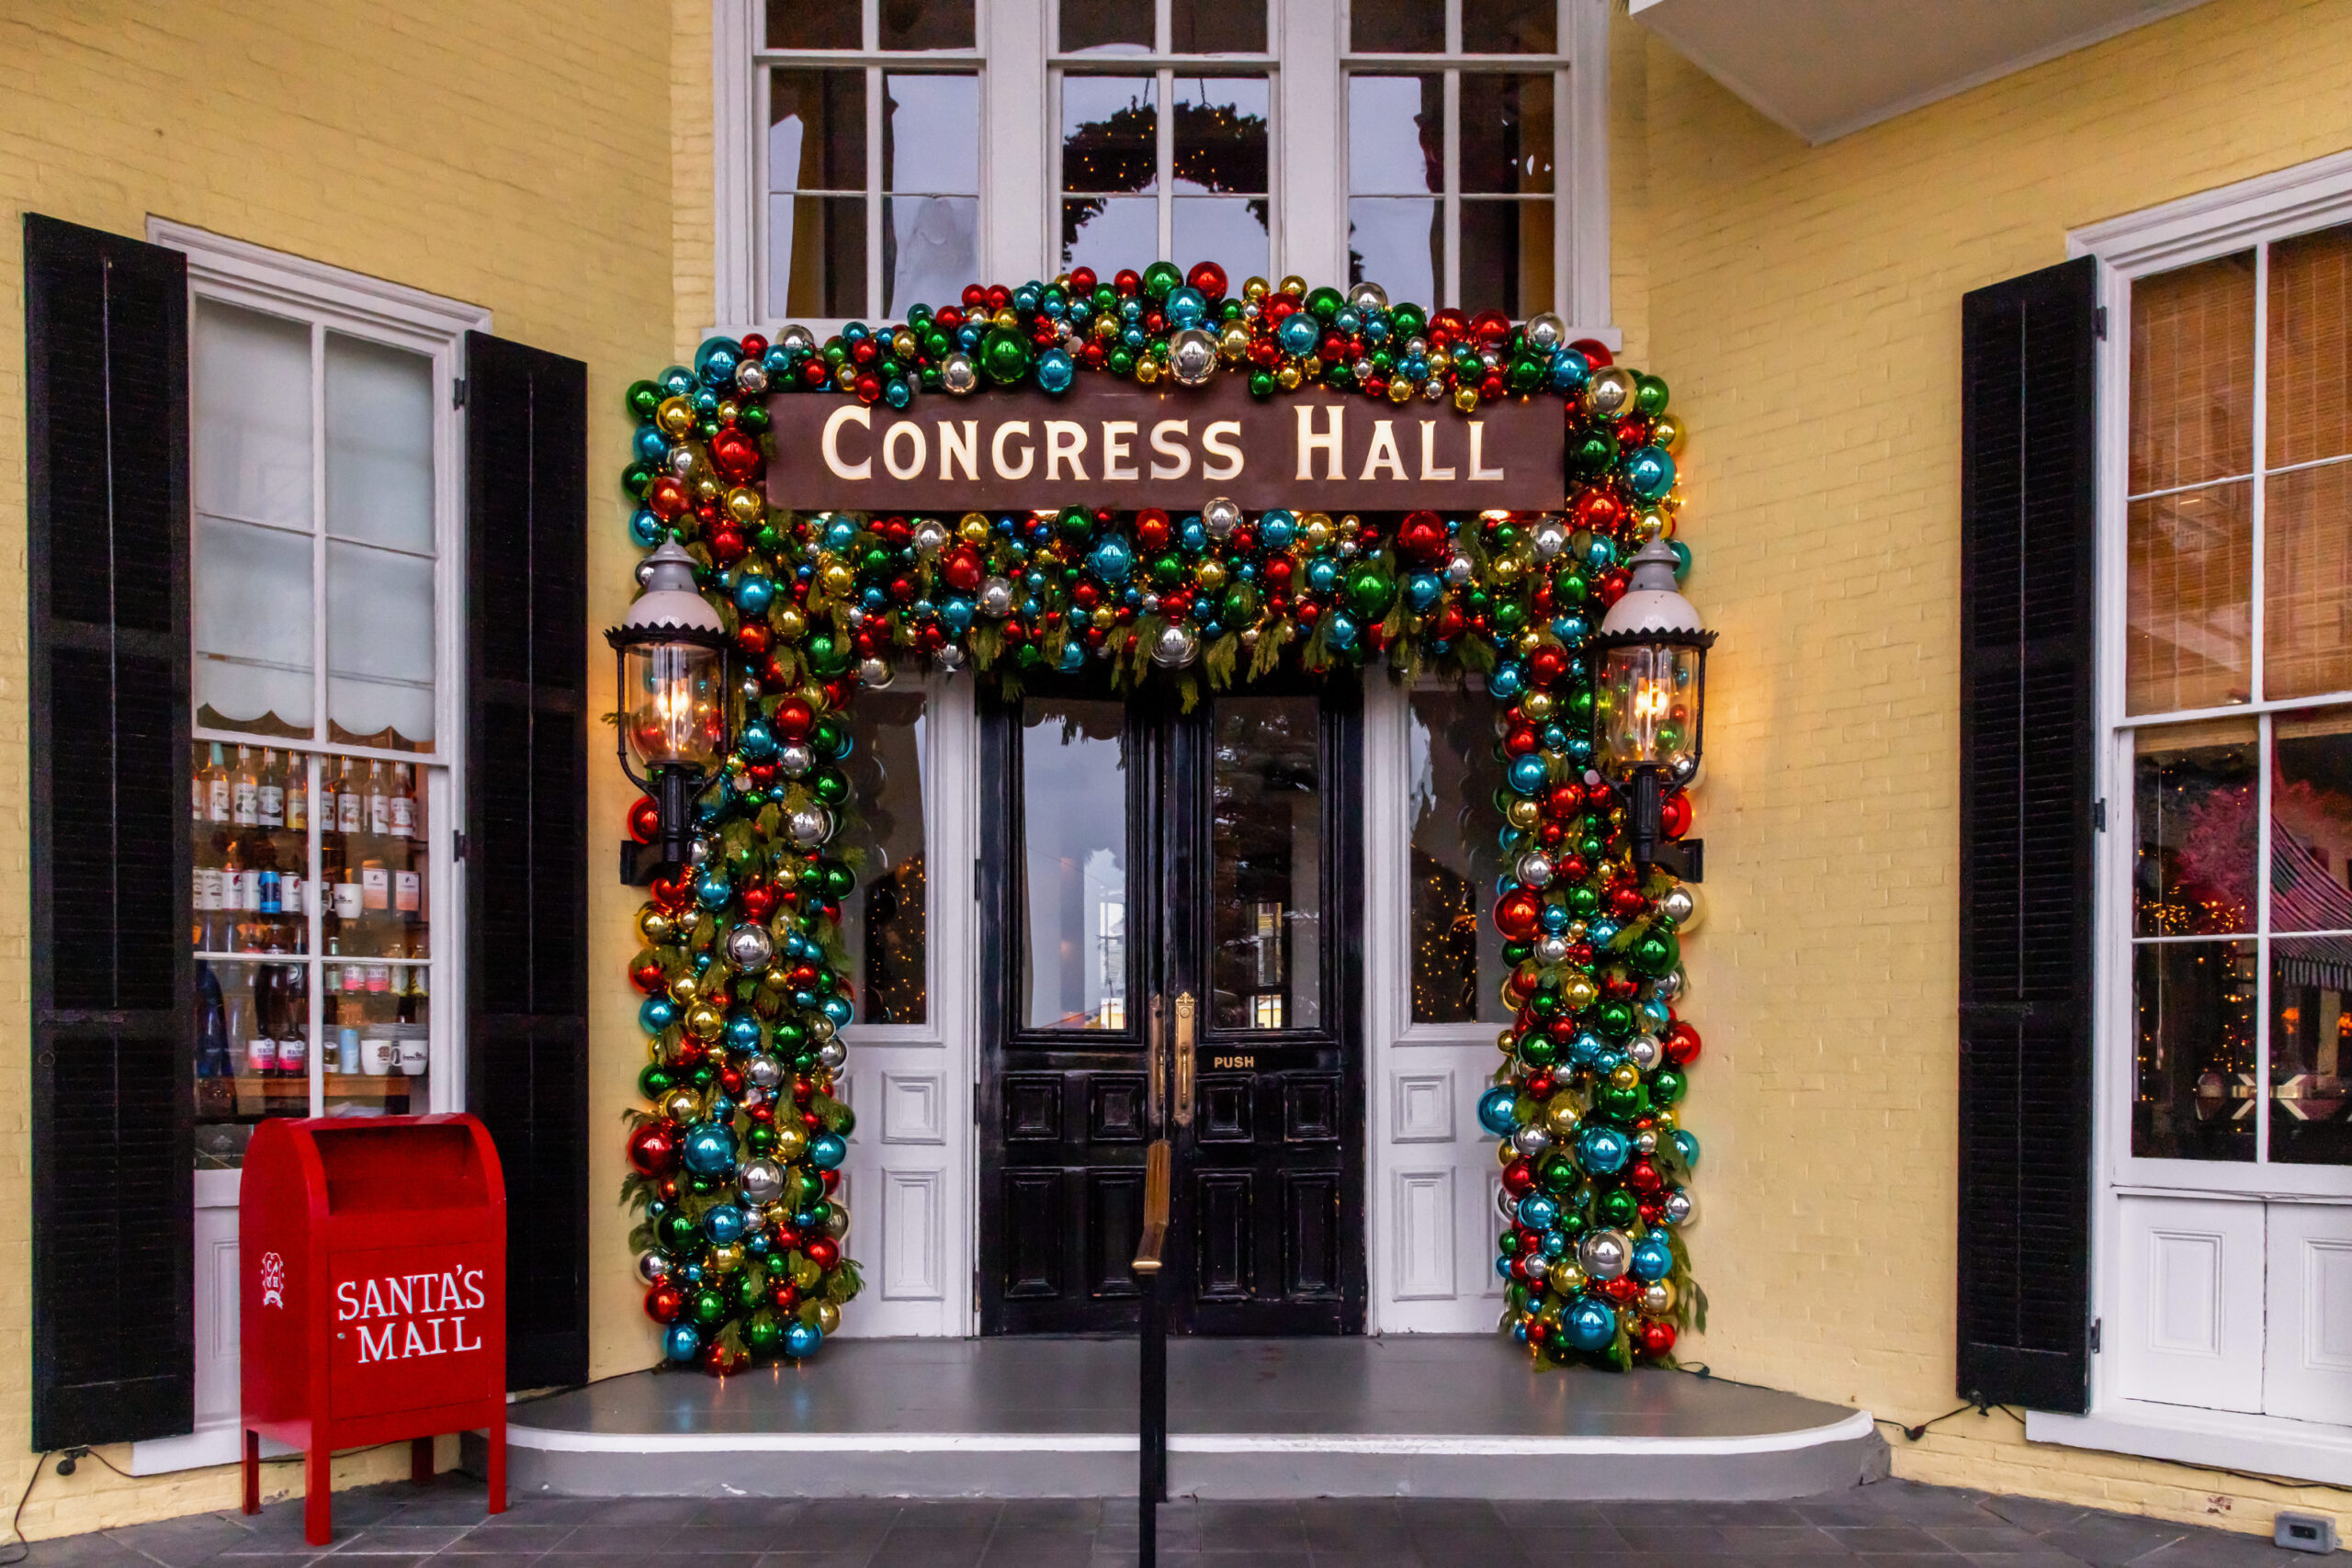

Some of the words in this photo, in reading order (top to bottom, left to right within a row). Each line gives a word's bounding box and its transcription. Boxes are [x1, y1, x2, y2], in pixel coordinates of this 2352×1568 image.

[1293, 404, 1505, 482] HALL
[1214, 1056, 1254, 1068] PUSH
[336, 1264, 485, 1321] SANTA'S
[356, 1316, 481, 1363] MAIL
